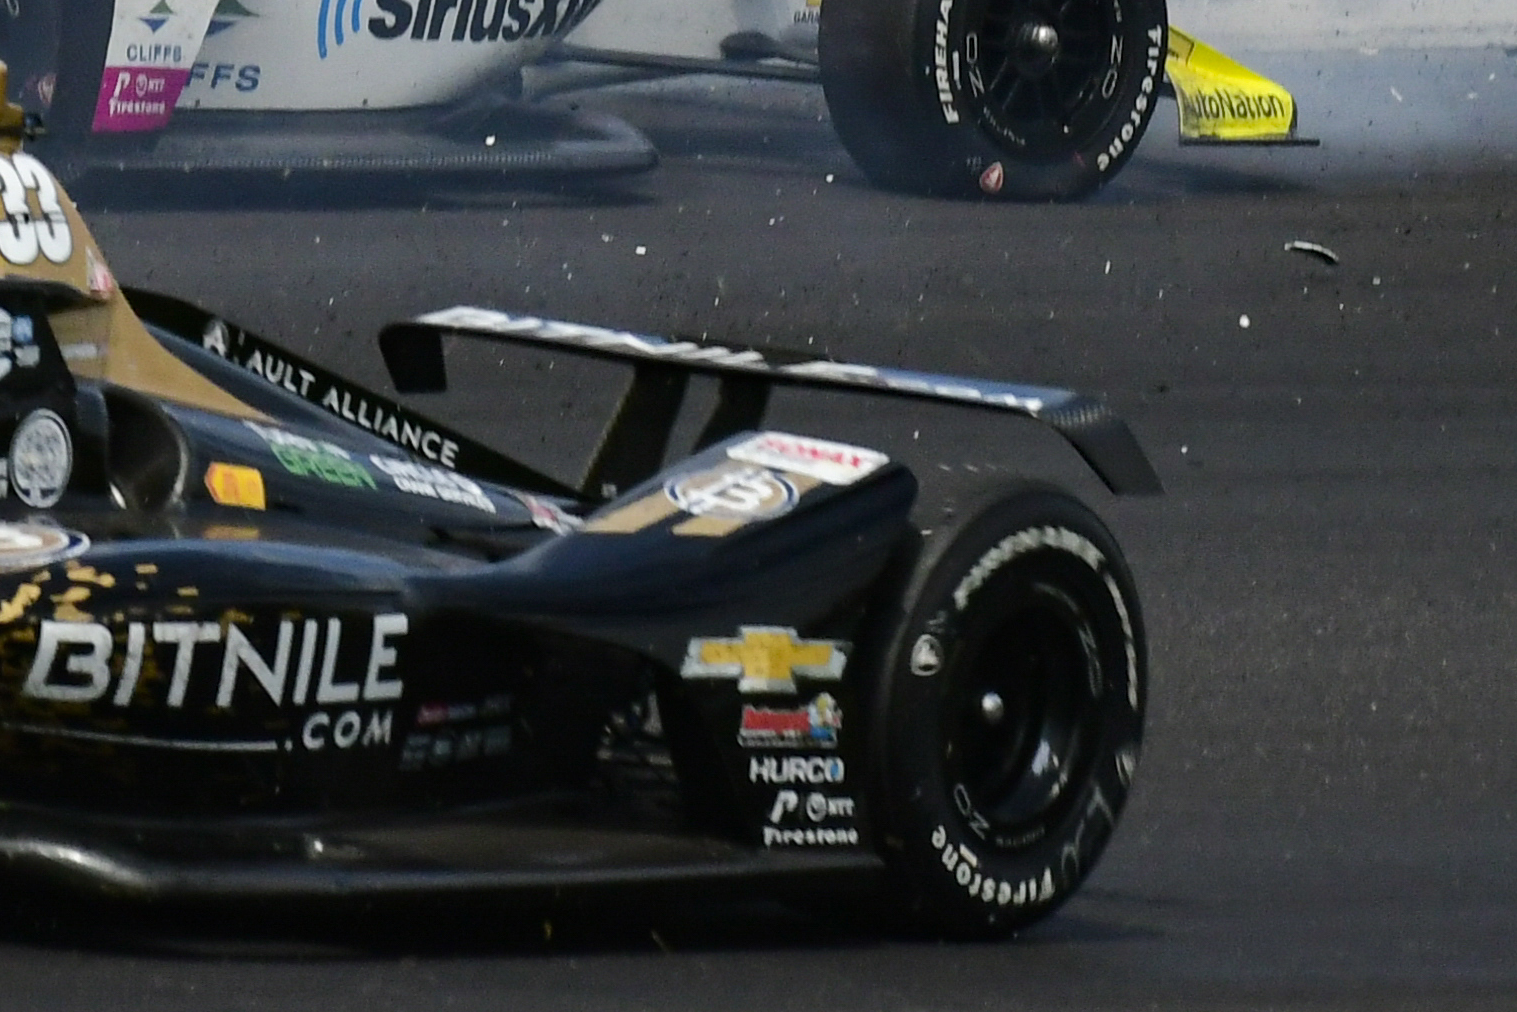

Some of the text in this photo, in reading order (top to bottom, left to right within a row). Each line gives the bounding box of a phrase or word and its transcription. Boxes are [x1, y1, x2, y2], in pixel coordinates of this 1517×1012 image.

[126, 44, 182, 63] CLIFFS
[1097, 24, 1162, 172] Firestone
[322, 387, 460, 469] ALLIANCE
[21, 613, 410, 708] BITNILE
[749, 755, 845, 784] HURCO
[763, 825, 859, 849] Firestone
[931, 824, 1055, 906] Firestone
